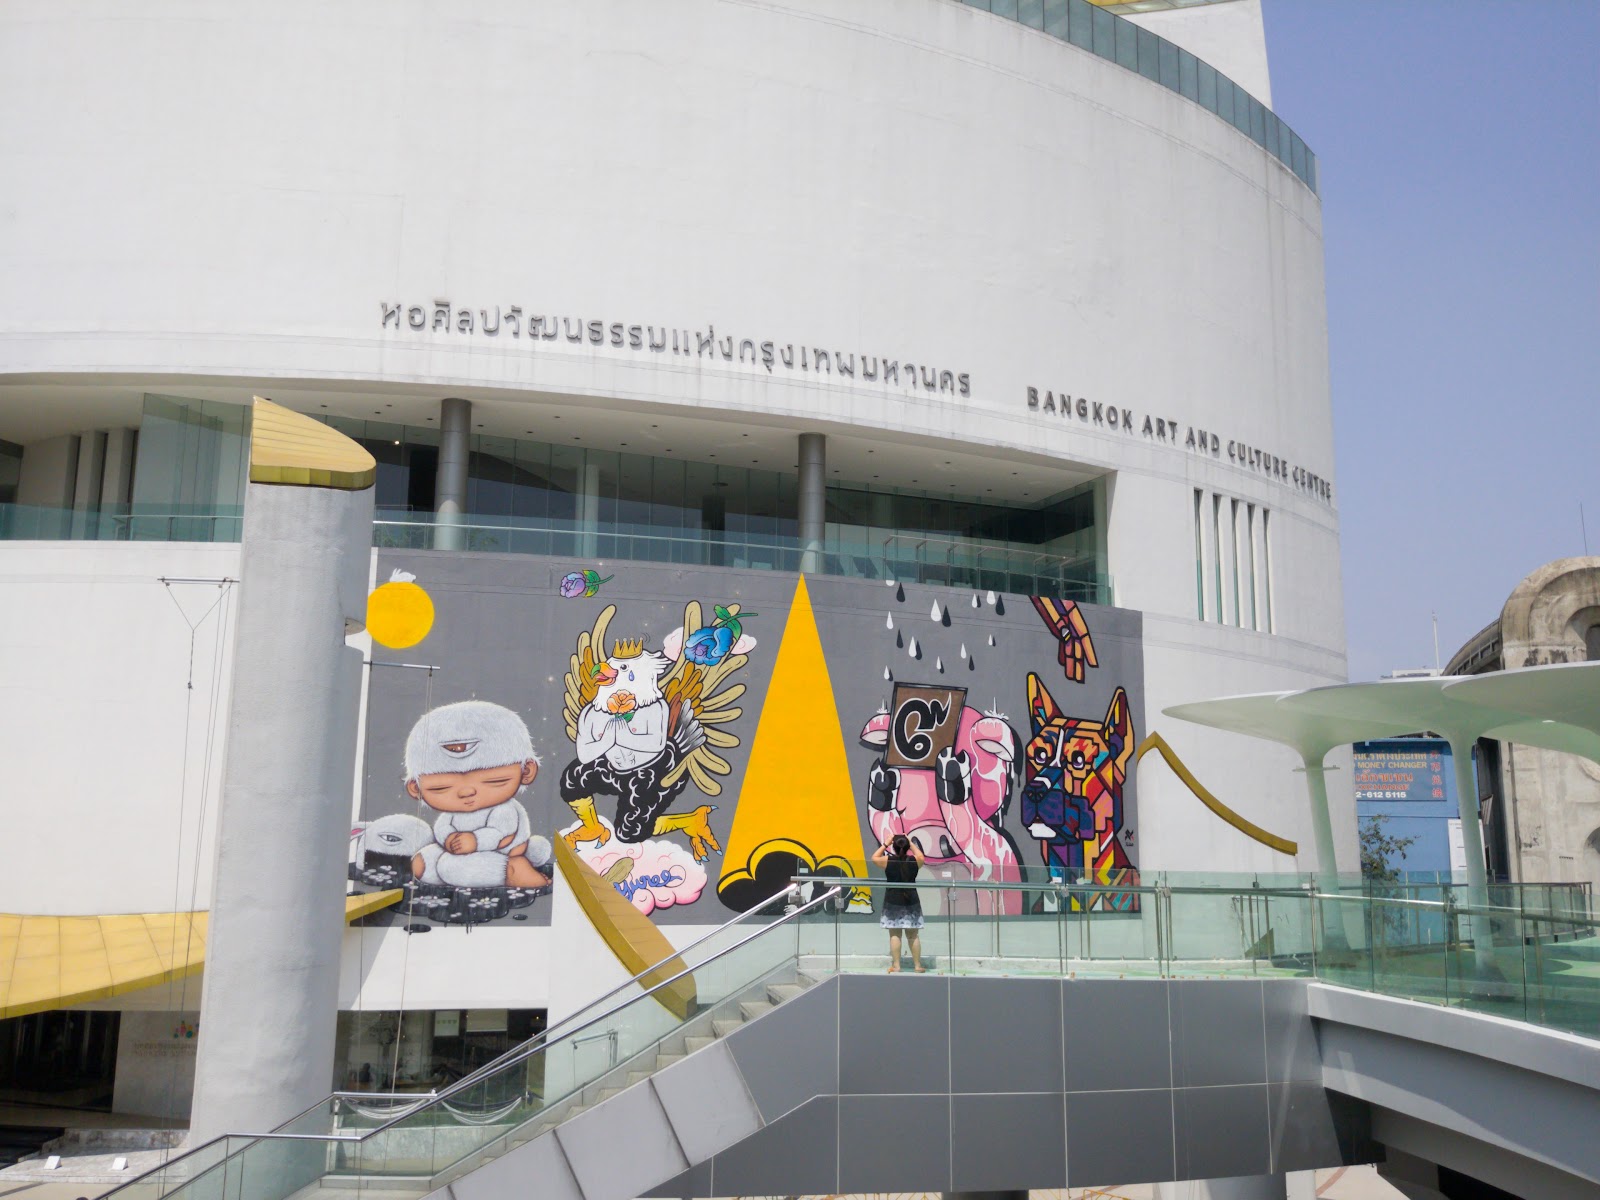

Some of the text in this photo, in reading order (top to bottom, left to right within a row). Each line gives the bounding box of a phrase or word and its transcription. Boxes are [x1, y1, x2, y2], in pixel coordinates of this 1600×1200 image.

[380, 299, 971, 398] หอศิลปวัฒนธรรมแห่งกรุงเทพมหานคร
[1026, 386, 1332, 500] BANGKOK ART AND CULTURE CENTRE
